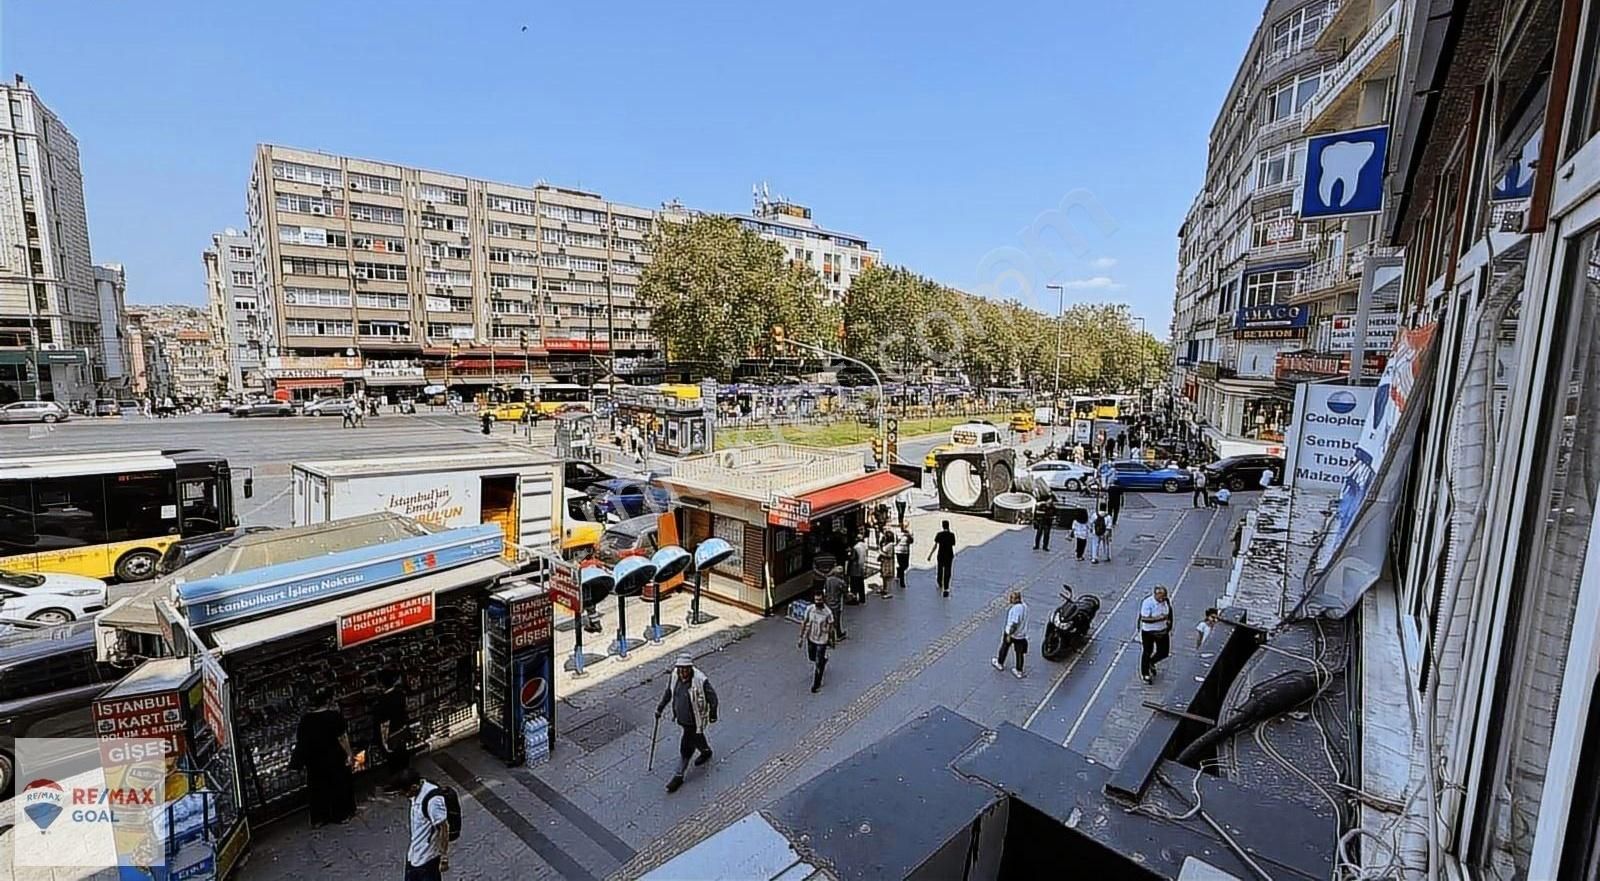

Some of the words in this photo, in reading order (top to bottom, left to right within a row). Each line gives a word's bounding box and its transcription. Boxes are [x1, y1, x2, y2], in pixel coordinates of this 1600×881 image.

[205, 588, 286, 616] İstanbulkart
[286, 583, 319, 602] İşlem
[321, 572, 365, 590] Noktası
[353, 616, 387, 631] DOLUM
[515, 622, 551, 646] GİŞESİ
[97, 696, 177, 716] İSTANBUL
[117, 712, 162, 730] KART
[108, 734, 179, 763] GİŞESİ
